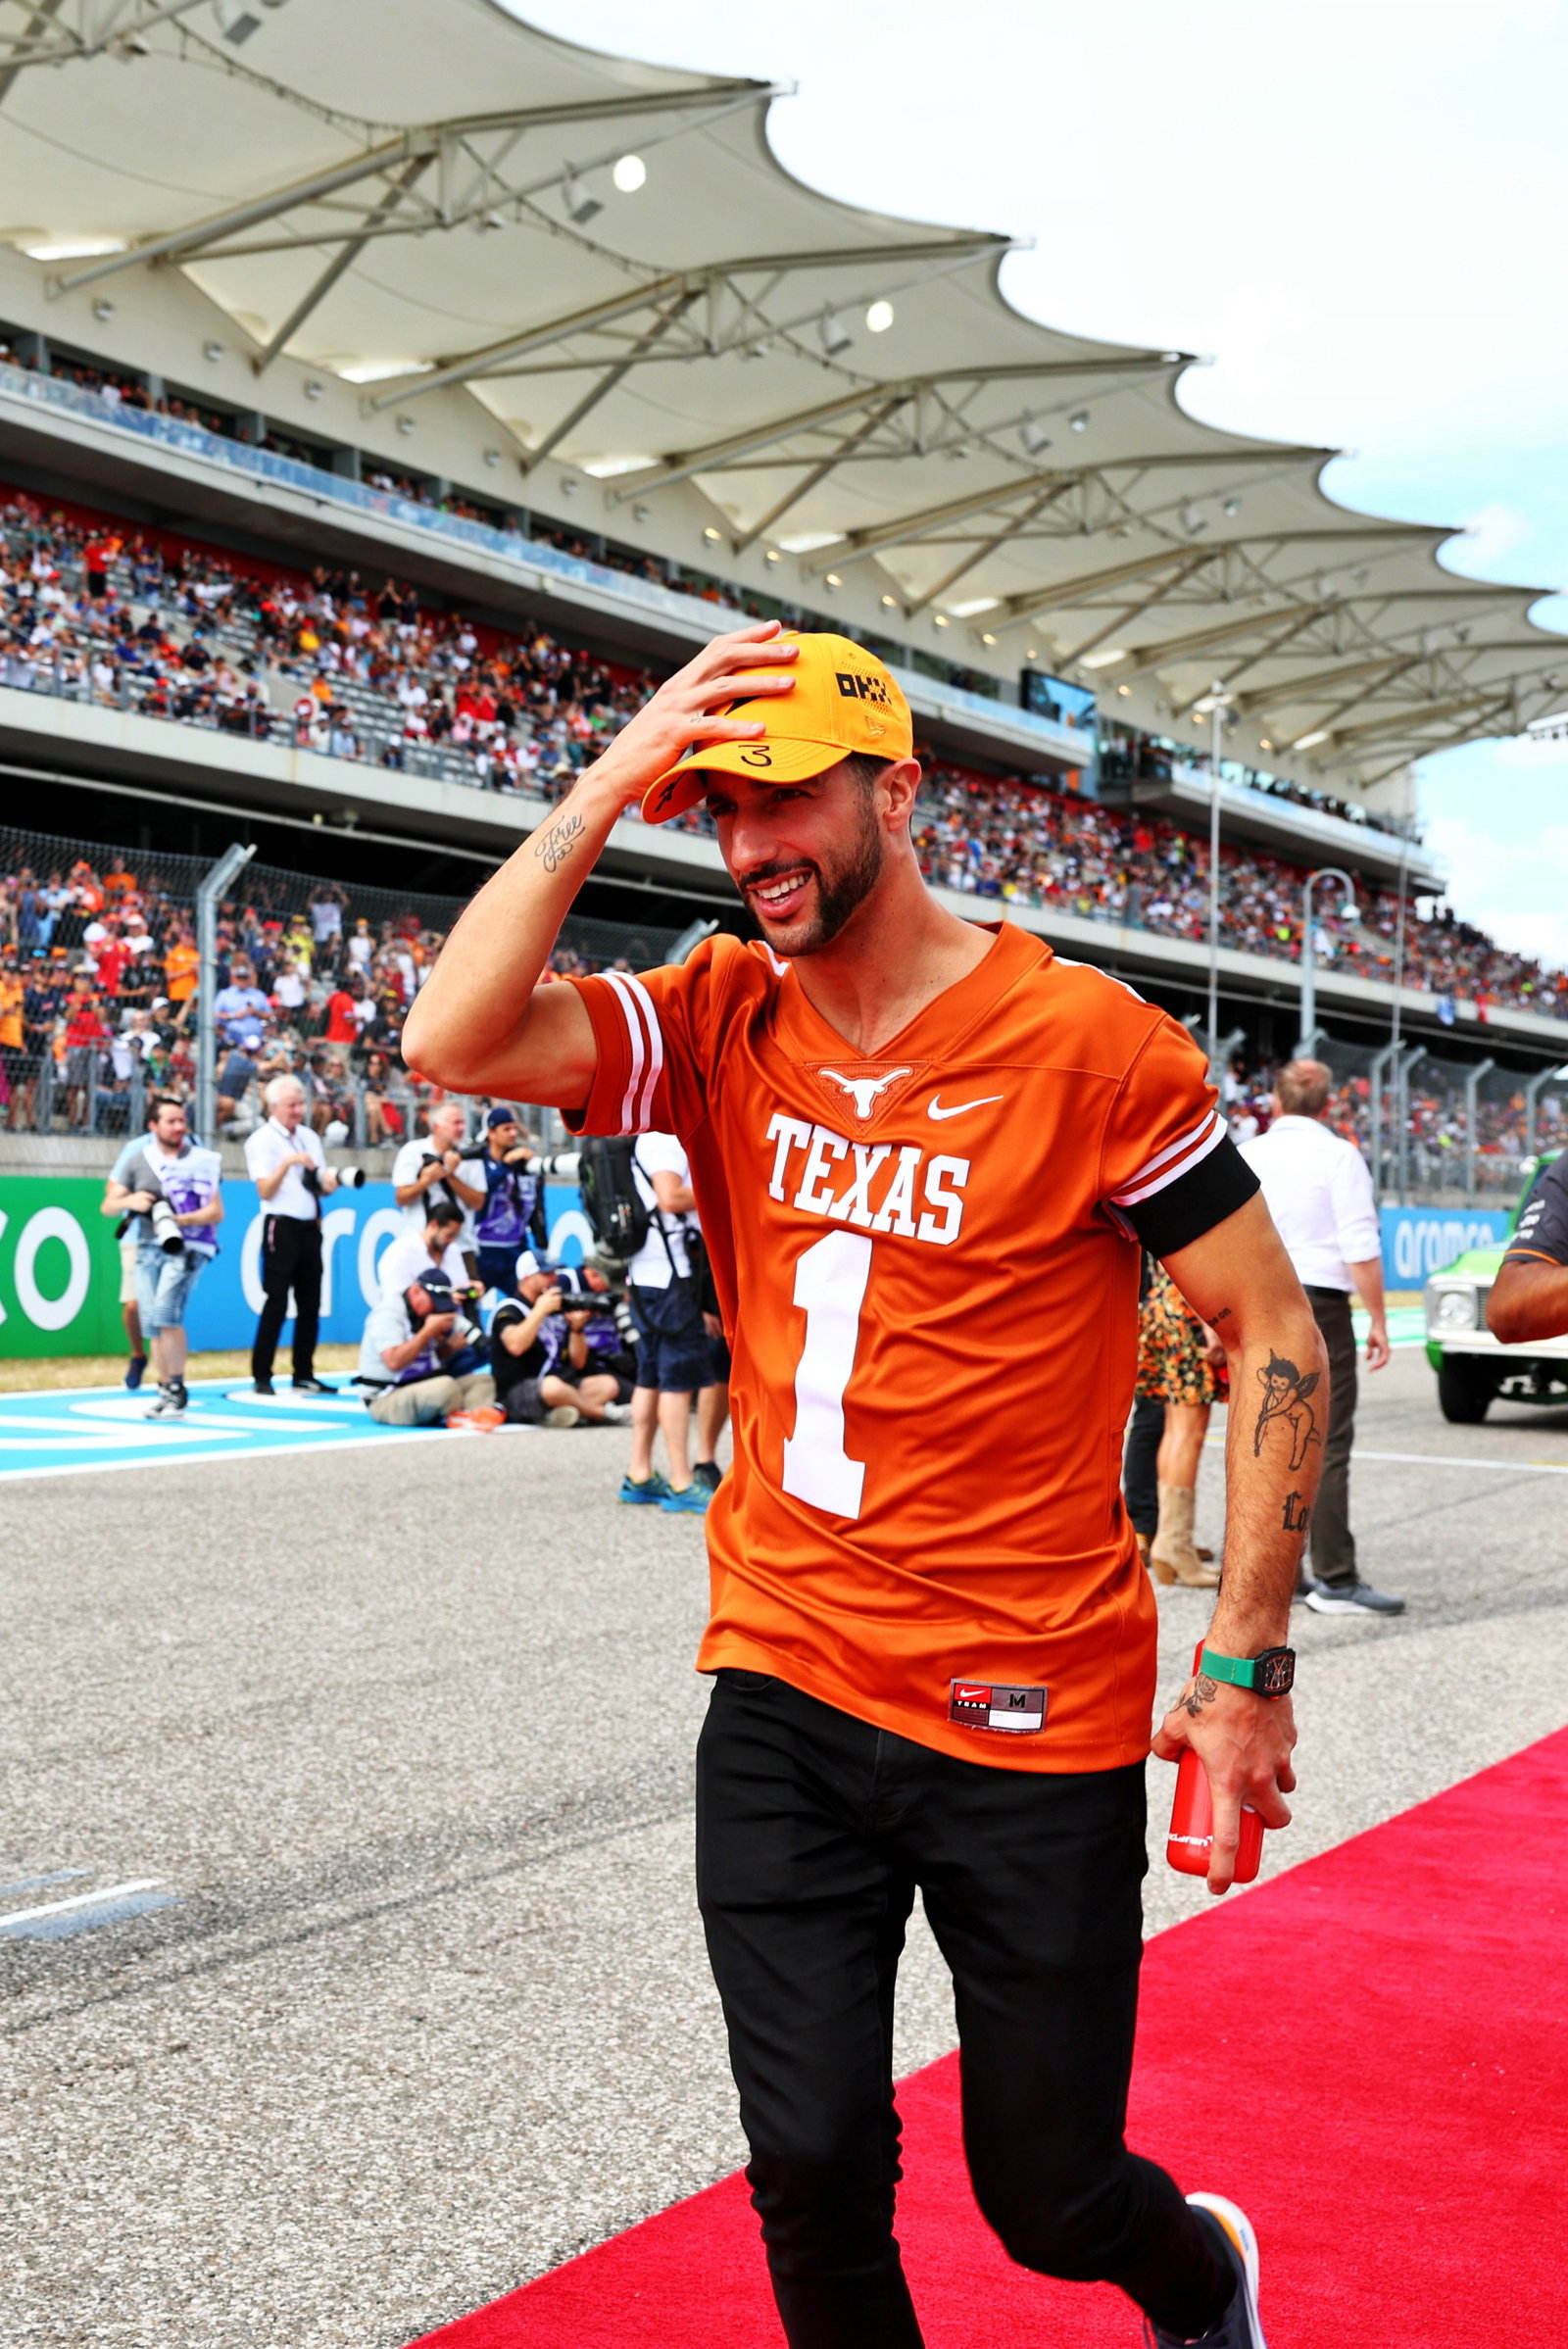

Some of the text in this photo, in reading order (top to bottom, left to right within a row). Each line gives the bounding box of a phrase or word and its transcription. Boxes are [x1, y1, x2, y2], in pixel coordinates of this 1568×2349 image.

[738, 744, 772, 767] 3
[765, 1113, 970, 1247] TEXAS
[781, 1229, 874, 1520] 1
[957, 1700, 987, 1709] TEAM
[1008, 1693, 1026, 1709] M
